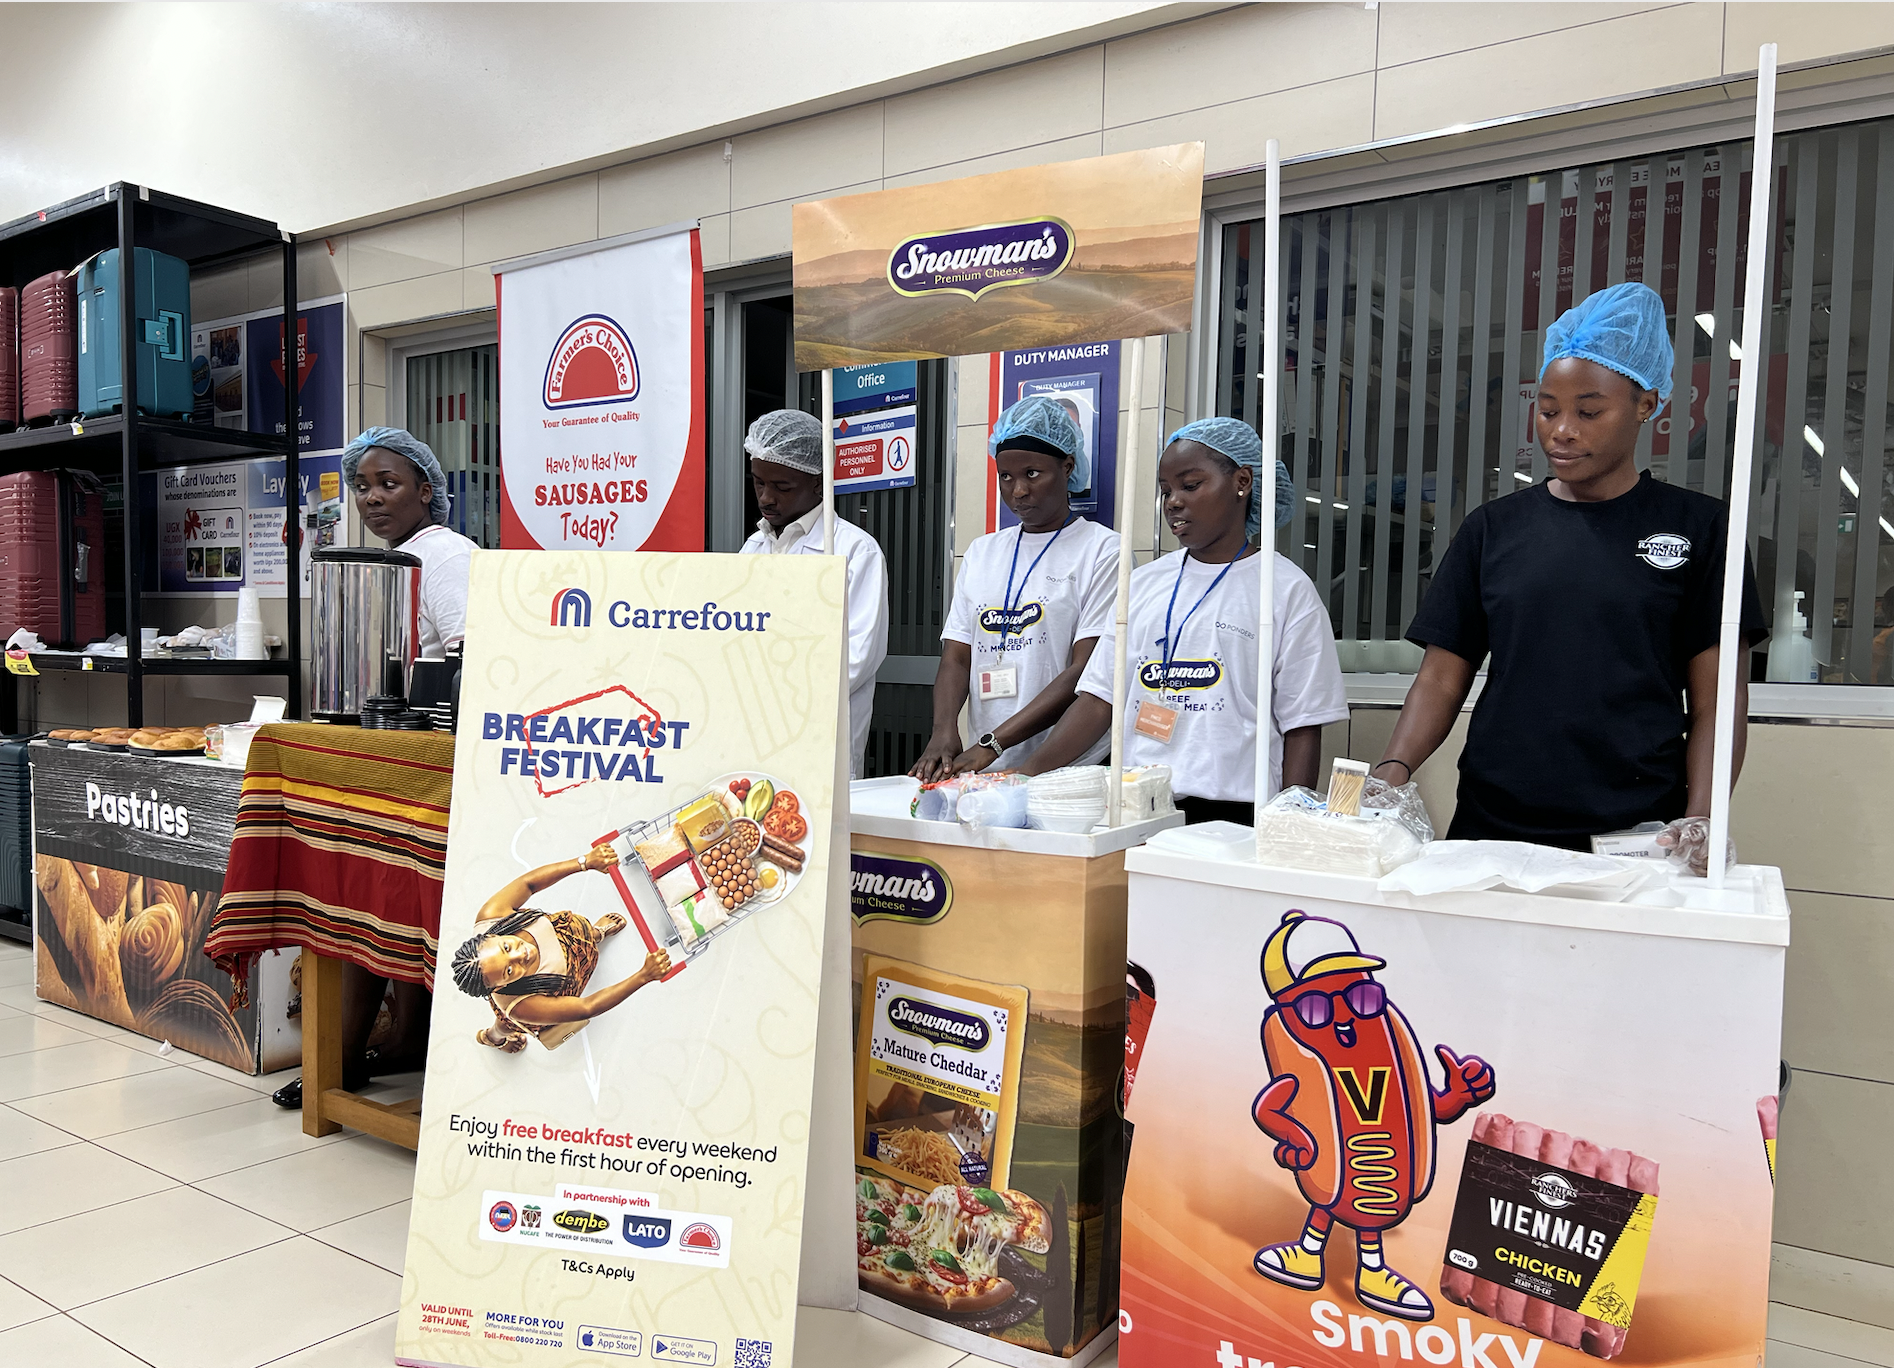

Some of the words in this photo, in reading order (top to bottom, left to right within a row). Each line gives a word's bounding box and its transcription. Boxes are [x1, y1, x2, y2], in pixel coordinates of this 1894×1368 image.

[897, 229, 1057, 279] Snowman's
[934, 272, 982, 284] Premium
[985, 266, 1025, 278] Cheese
[551, 328, 593, 394] Farmer's
[596, 330, 628, 386] Choice
[1014, 352, 1046, 366] DUTY
[1048, 344, 1109, 362] MANAGER
[858, 374, 886, 388] Office
[1054, 380, 1086, 388] MANAGER
[542, 419, 560, 429] Your
[562, 416, 600, 427] Guarantee
[602, 412, 610, 422] of
[612, 411, 640, 424] Quality
[862, 420, 894, 432] Information
[839, 443, 876, 457] AUTHORISED
[546, 456, 570, 474] Have
[573, 454, 590, 473] You
[592, 453, 611, 470] Had
[614, 452, 638, 468] Your
[840, 455, 876, 466] PERSONNEL
[165, 475, 179, 488] Gift
[181, 474, 198, 487] Card
[200, 472, 236, 486] Vouchers
[850, 466, 866, 476] ONLY
[165, 492, 182, 500] whose
[184, 489, 225, 500] denominations
[262, 474, 286, 498] Lay
[534, 479, 648, 507] SAUSAGES
[166, 522, 180, 533] UGX
[203, 518, 216, 526] GIFT
[560, 510, 619, 548] Today?
[202, 531, 218, 540] CARD
[1648, 549, 1682, 558] FINEST
[608, 601, 771, 632] Carrefour
[1227, 624, 1256, 640] PONDERS
[482, 712, 690, 750] BREAKFAST
[500, 748, 664, 784] FESTIVAL
[86, 782, 190, 837] Pastries
[868, 896, 906, 912] Cheese
[891, 1000, 983, 1041] Snowman's
[912, 1025, 939, 1038] Premium
[940, 1032, 964, 1044] Cheese
[884, 1038, 926, 1064] Mature
[930, 1052, 988, 1082] Cheddar
[886, 1064, 922, 1082] TRADITIONAL
[924, 1077, 956, 1091] EUROPEAN
[957, 1086, 981, 1098] CHEESE
[1332, 1066, 1392, 1125] V
[450, 1114, 498, 1138] Enjoy
[502, 1119, 538, 1139] free
[542, 1124, 633, 1148] breakfast
[637, 1136, 688, 1158] every
[692, 1142, 777, 1163] weekend
[468, 1142, 522, 1162] within
[526, 1146, 556, 1164] the
[560, 1148, 596, 1169] first
[600, 1154, 643, 1173] hour
[646, 1158, 668, 1176] of
[670, 1163, 752, 1188] opening.
[564, 1190, 572, 1199] In
[574, 1191, 628, 1206] partnership
[629, 1197, 650, 1207] with
[556, 1212, 608, 1234] dembe
[628, 1222, 666, 1240] LATO
[1490, 1197, 1606, 1260] VIENNAS
[580, 1236, 614, 1245] DISTRIBUTION
[1452, 1252, 1468, 1263] 700
[561, 1259, 593, 1274] T&Cs
[596, 1264, 634, 1281] Apply
[1494, 1247, 1582, 1288] CHICKEN
[421, 1303, 446, 1315] VALID
[448, 1306, 474, 1318] UNTIL
[422, 1314, 444, 1325] 28TH
[445, 1317, 470, 1329] JUNE,
[486, 1312, 516, 1324] MORE
[518, 1316, 539, 1327] FOR
[542, 1318, 564, 1330] YOU
[501, 1324, 525, 1332] available
[418, 1325, 432, 1334] only
[442, 1328, 471, 1337] weekends
[1310, 1300, 1544, 1368] smoky
[535, 1337, 548, 1346] 220
[550, 1339, 562, 1348] 720
[598, 1338, 614, 1350] App
[616, 1341, 637, 1351] Store
[670, 1347, 695, 1359] Google
[697, 1351, 711, 1361] Play
